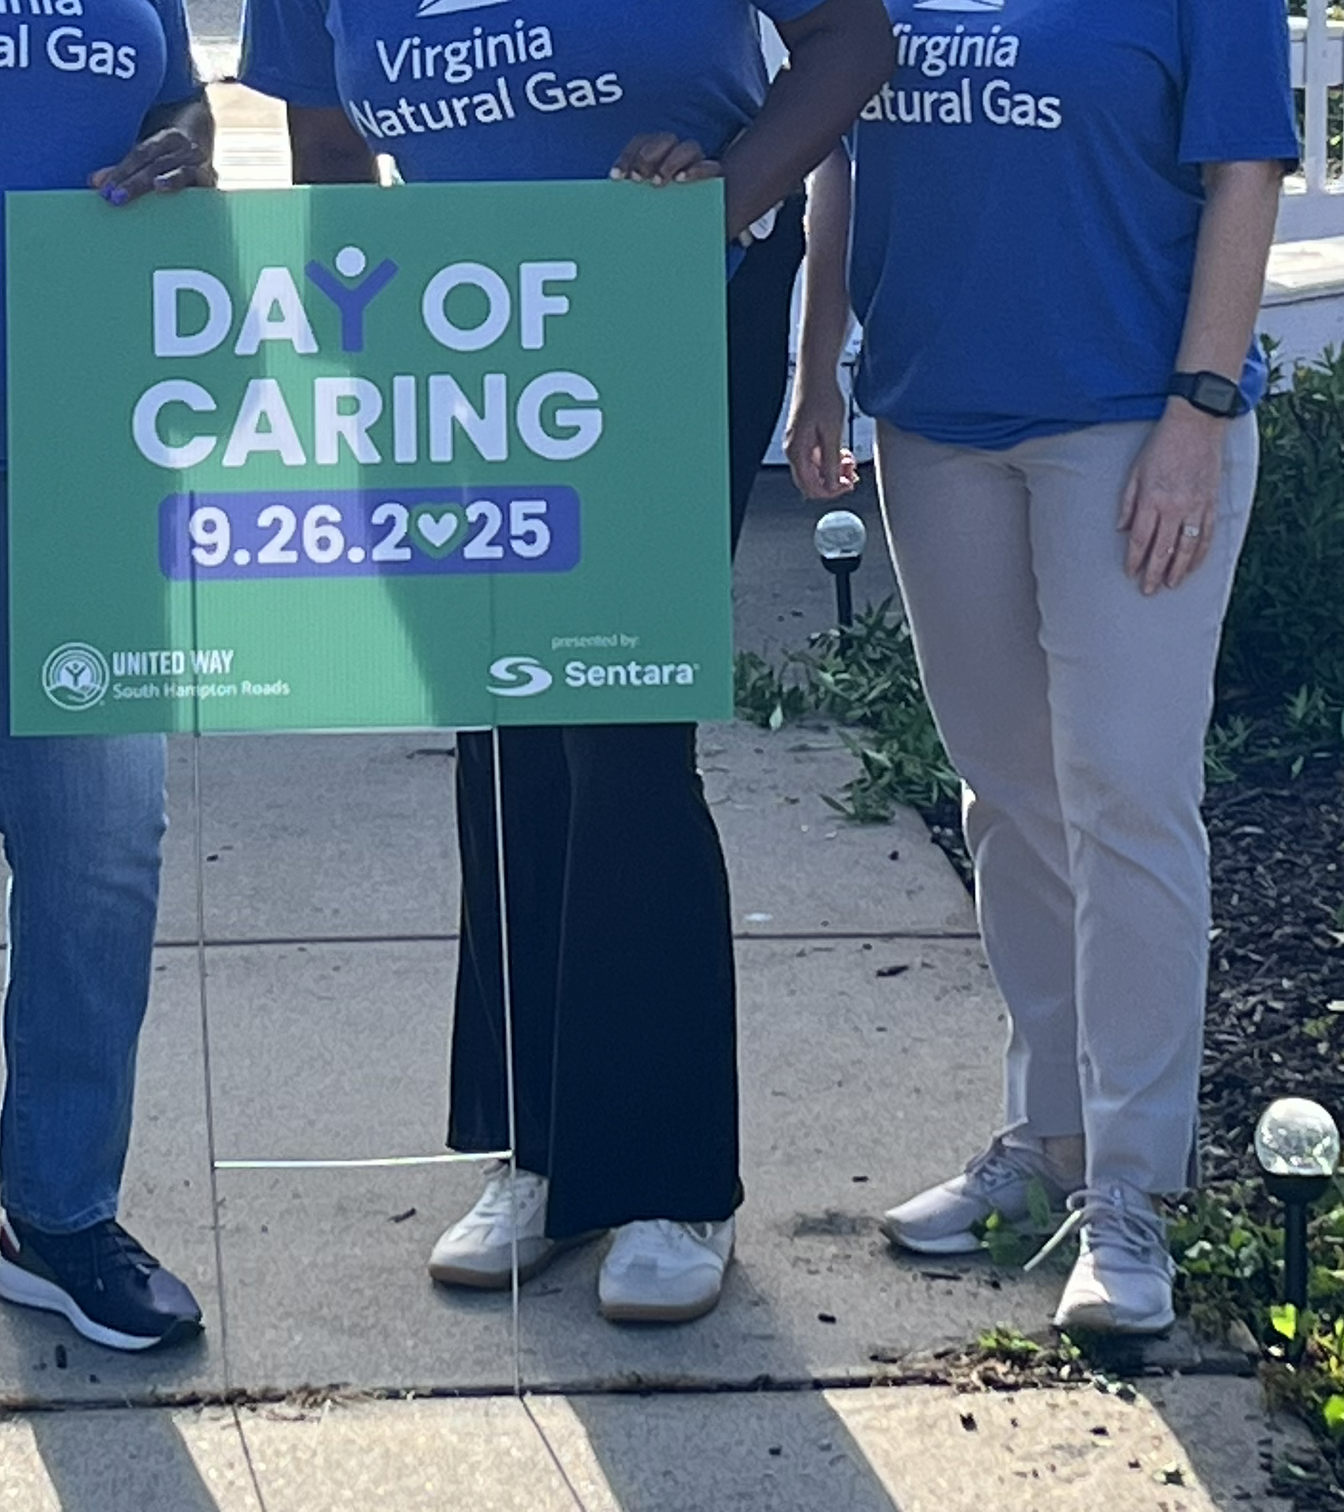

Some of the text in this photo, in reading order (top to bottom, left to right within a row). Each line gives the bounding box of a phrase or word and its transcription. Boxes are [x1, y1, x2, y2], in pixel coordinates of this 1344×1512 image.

[46, 26, 137, 80] Gas
[375, 18, 554, 84] Virginia
[892, 23, 1020, 78] irginia
[349, 71, 624, 139] Natural Gas
[860, 78, 1062, 129] atural Gas
[152, 250, 579, 358] DAY OF
[132, 371, 604, 470] CARING
[112, 649, 235, 677] UNITED WAY
[551, 634, 617, 650] presented
[112, 679, 291, 700] South Hampton Roads
[564, 660, 694, 687] Sentara
